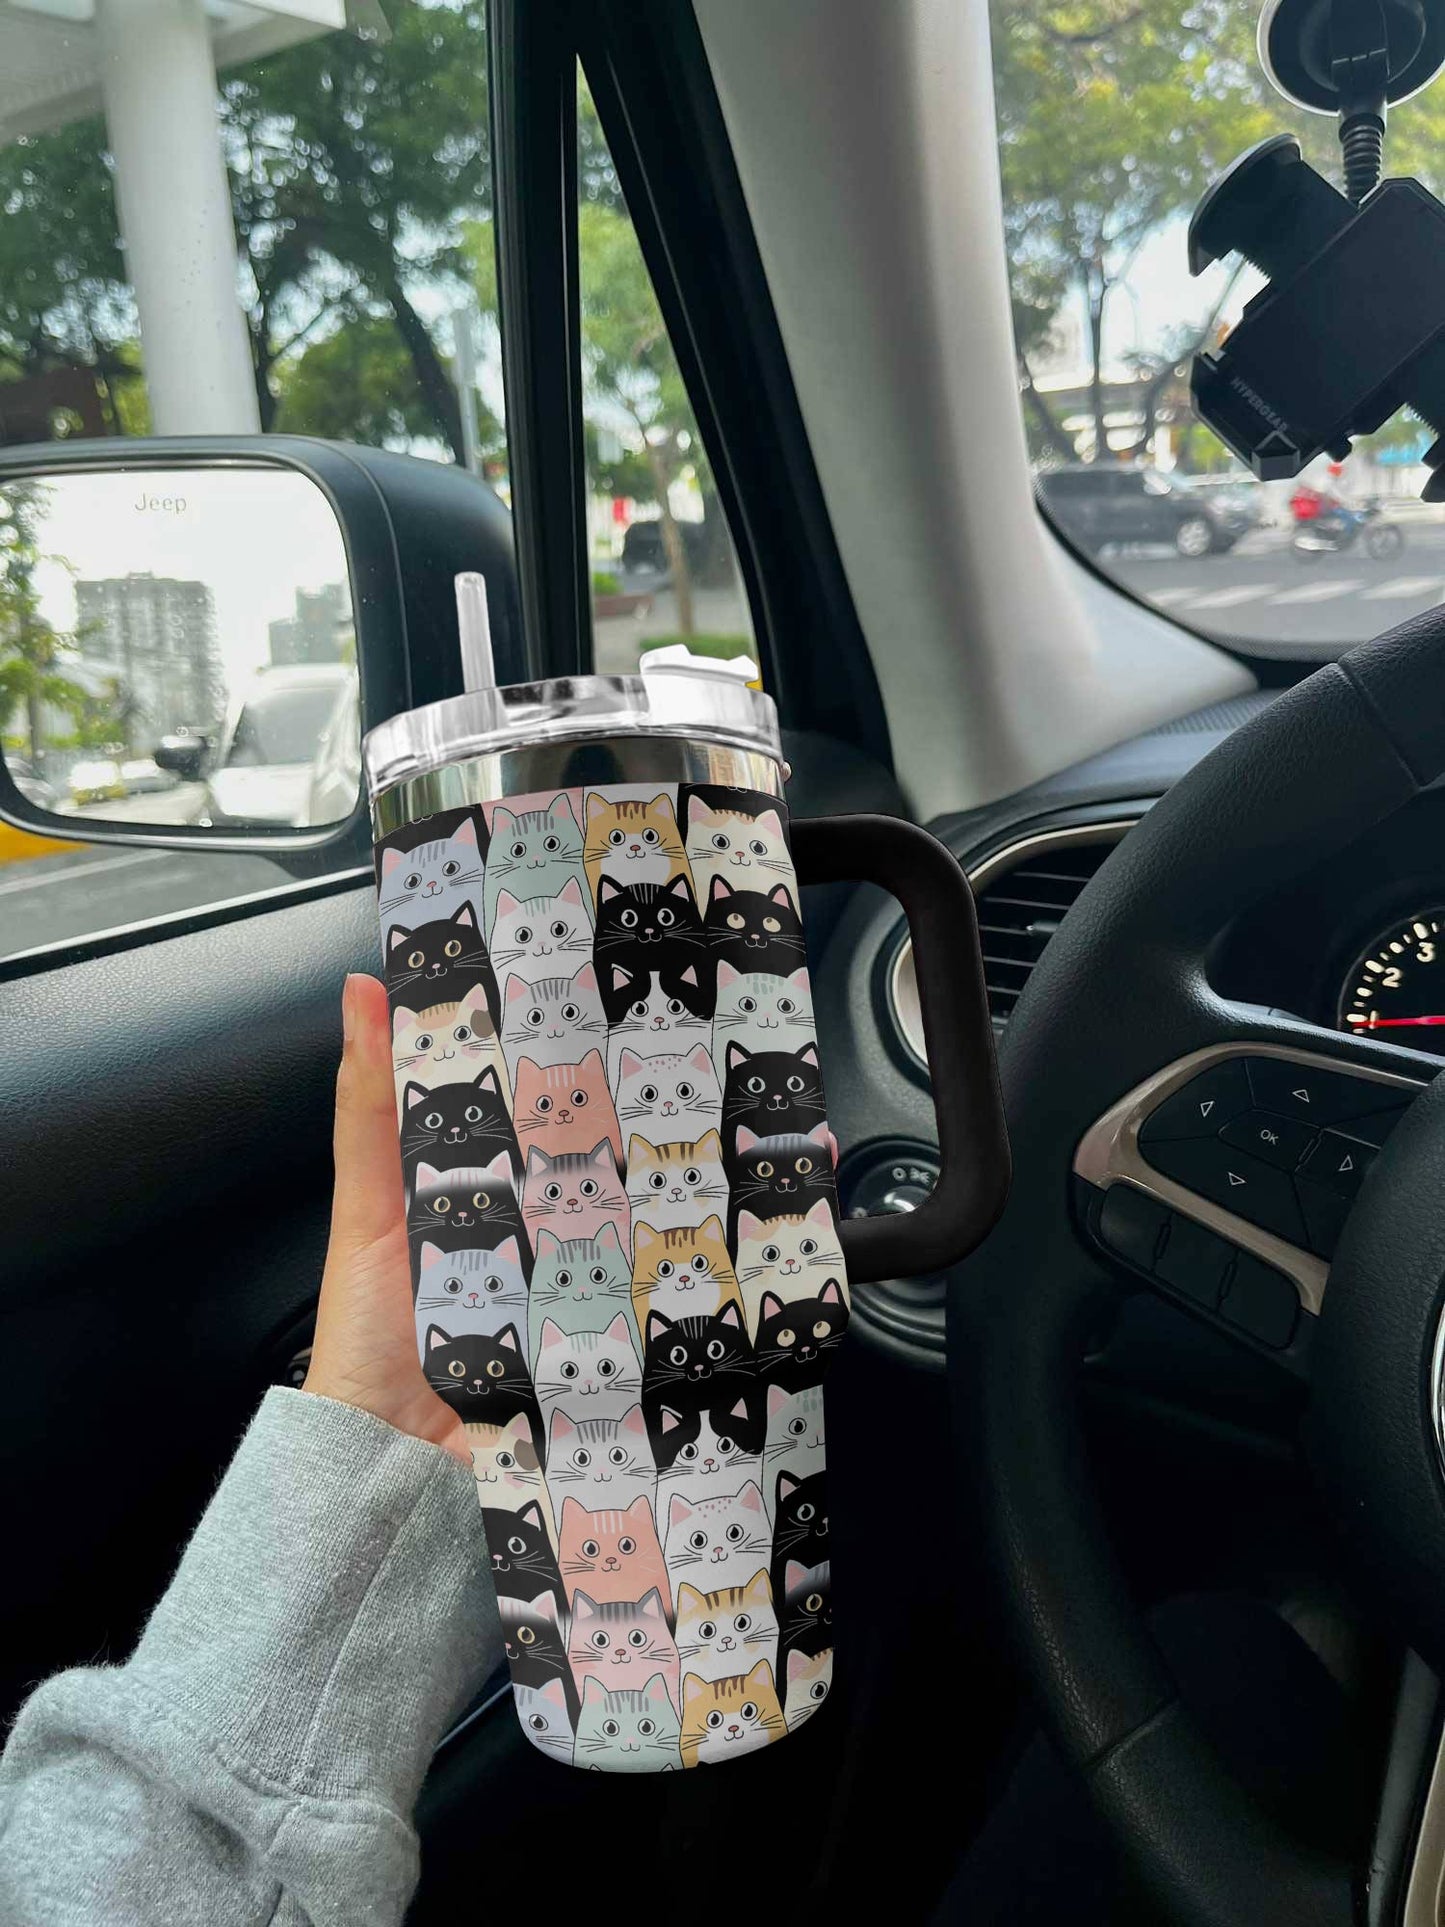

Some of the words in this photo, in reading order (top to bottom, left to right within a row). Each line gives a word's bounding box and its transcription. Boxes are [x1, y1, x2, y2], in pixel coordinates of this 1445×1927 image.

[1230, 377, 1288, 432] HYPERGEAR
[134, 492, 187, 515] Jeep
[1416, 942, 1436, 963] 3
[1382, 967, 1404, 988] 2
[1260, 1129, 1279, 1145] OK
